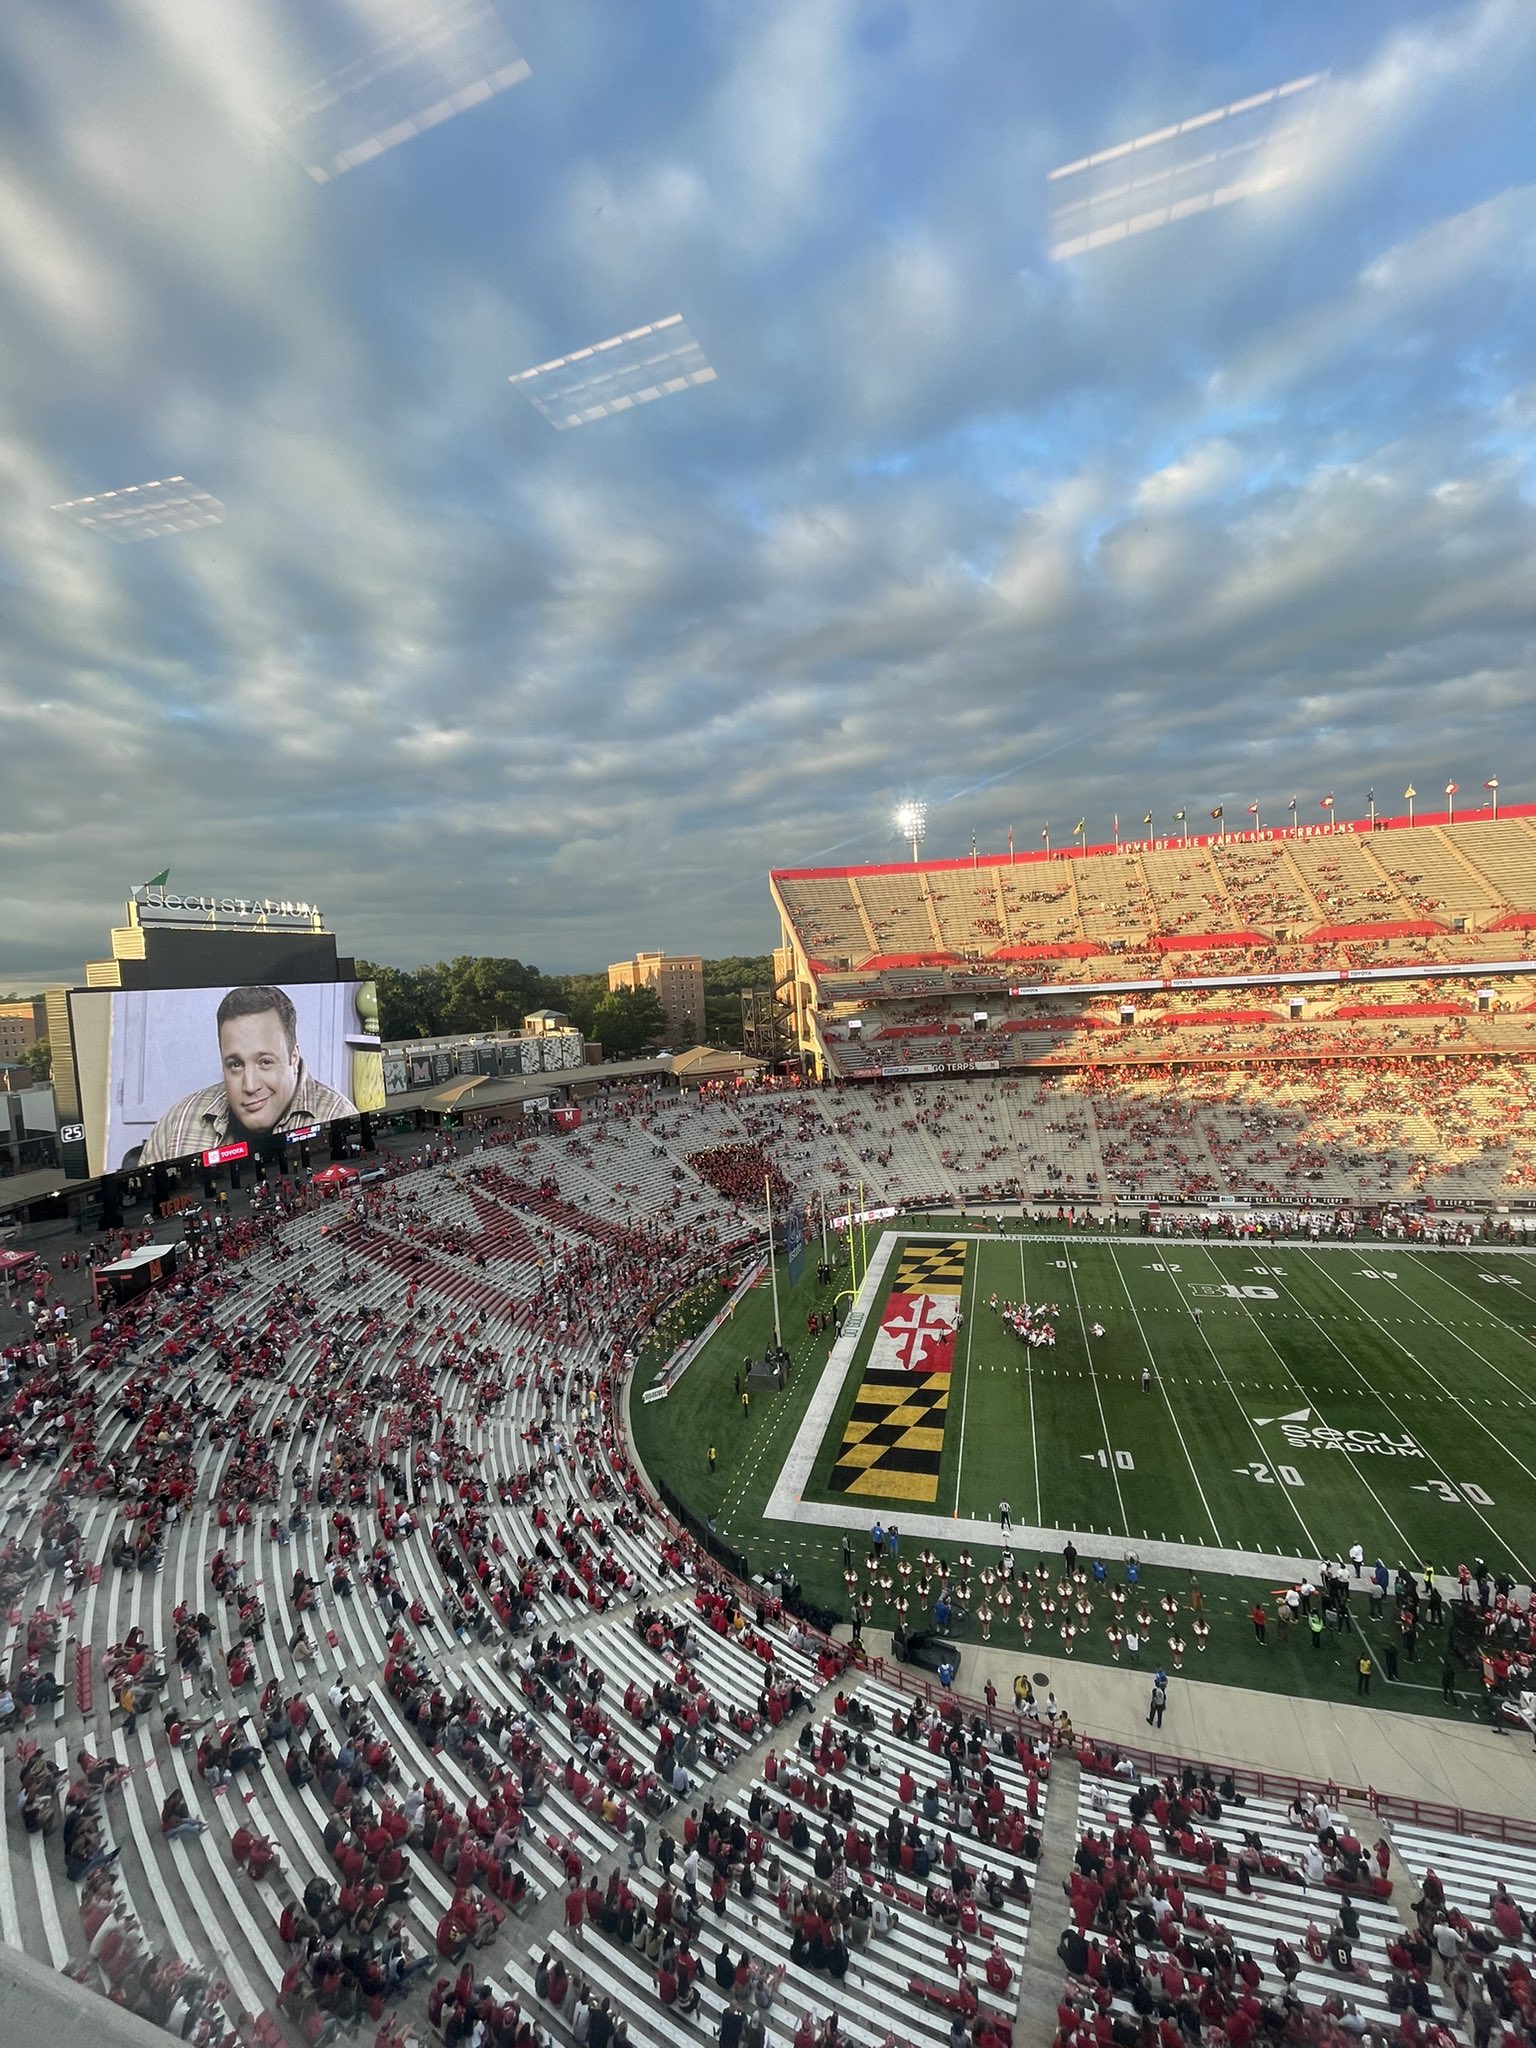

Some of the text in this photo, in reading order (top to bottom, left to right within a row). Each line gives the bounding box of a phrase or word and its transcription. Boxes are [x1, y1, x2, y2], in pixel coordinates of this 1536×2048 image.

[1118, 823, 1354, 854] HOME OF THE MARYLAND TERRAPINS
[221, 898, 319, 918] STADIUM
[932, 1062, 975, 1073] GO TERPS
[565, 1111, 573, 1121] M
[65, 1126, 82, 1140] 25
[221, 1147, 244, 1158] TOYOTA
[1055, 1260, 1078, 1269] 10
[1152, 1263, 1183, 1272] 20
[1252, 1266, 1289, 1276] 30
[1477, 1274, 1522, 1284] 50
[1286, 1438, 1425, 1458] STADIUM
[1098, 1449, 1135, 1470] 10
[1248, 1462, 1305, 1487] 20
[1426, 1479, 1496, 1506] 30
[1338, 1949, 1347, 1964] 8
